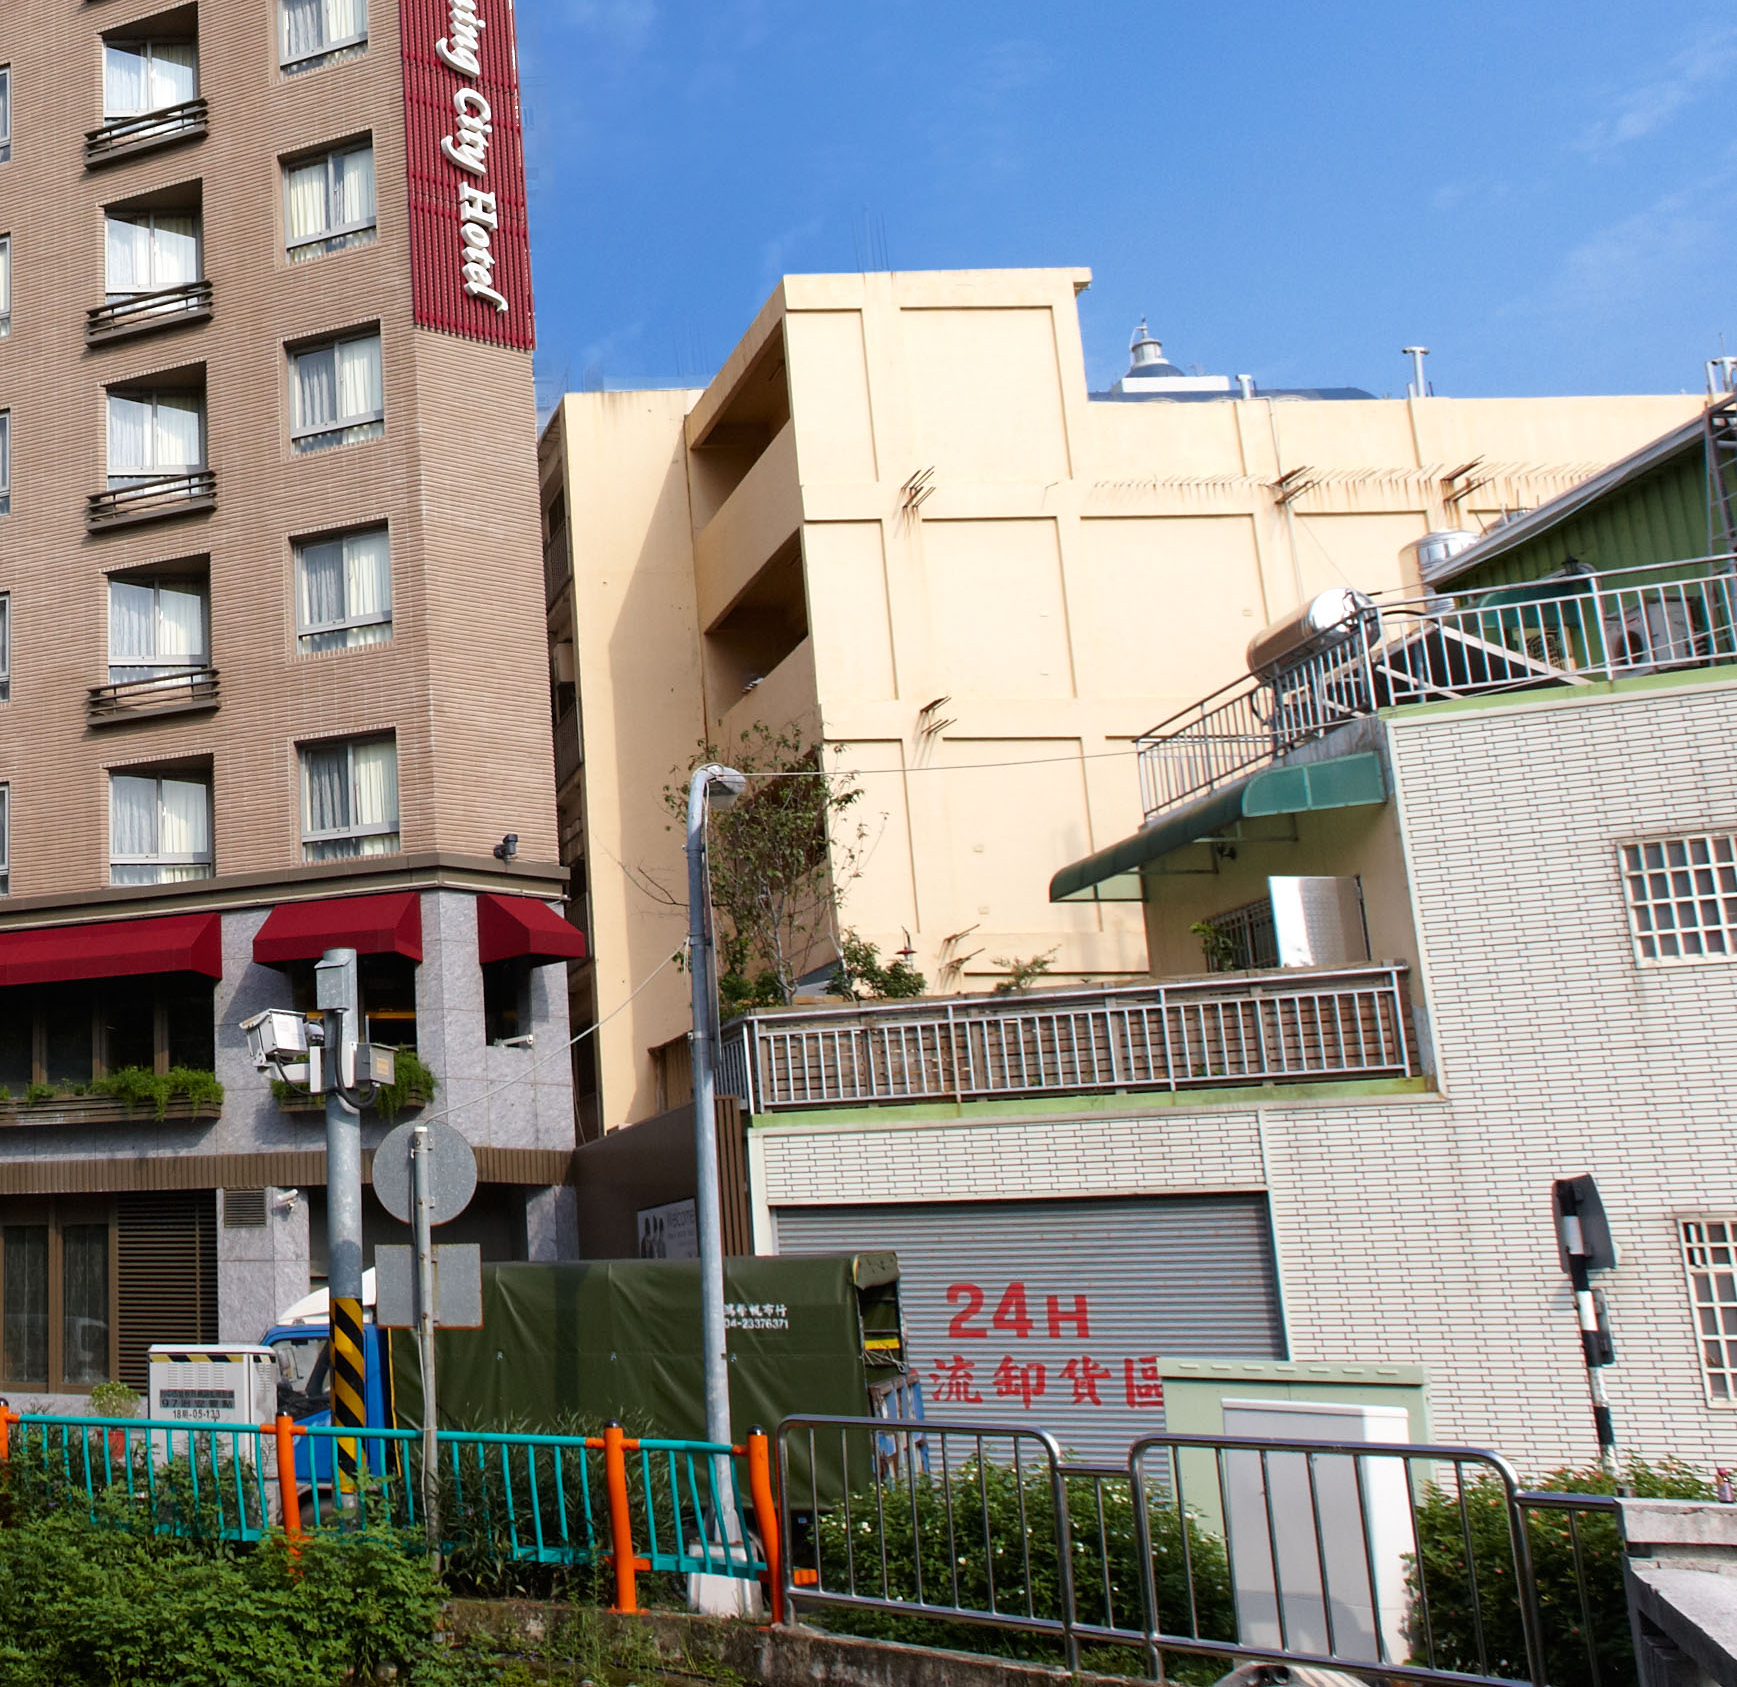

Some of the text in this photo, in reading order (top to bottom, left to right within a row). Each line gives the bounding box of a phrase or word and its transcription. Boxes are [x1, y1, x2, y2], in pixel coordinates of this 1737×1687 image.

[441, 88, 492, 176] City
[458, 181, 508, 312] Hotel
[910, 1355, 1164, 1409] 流卸貨區
